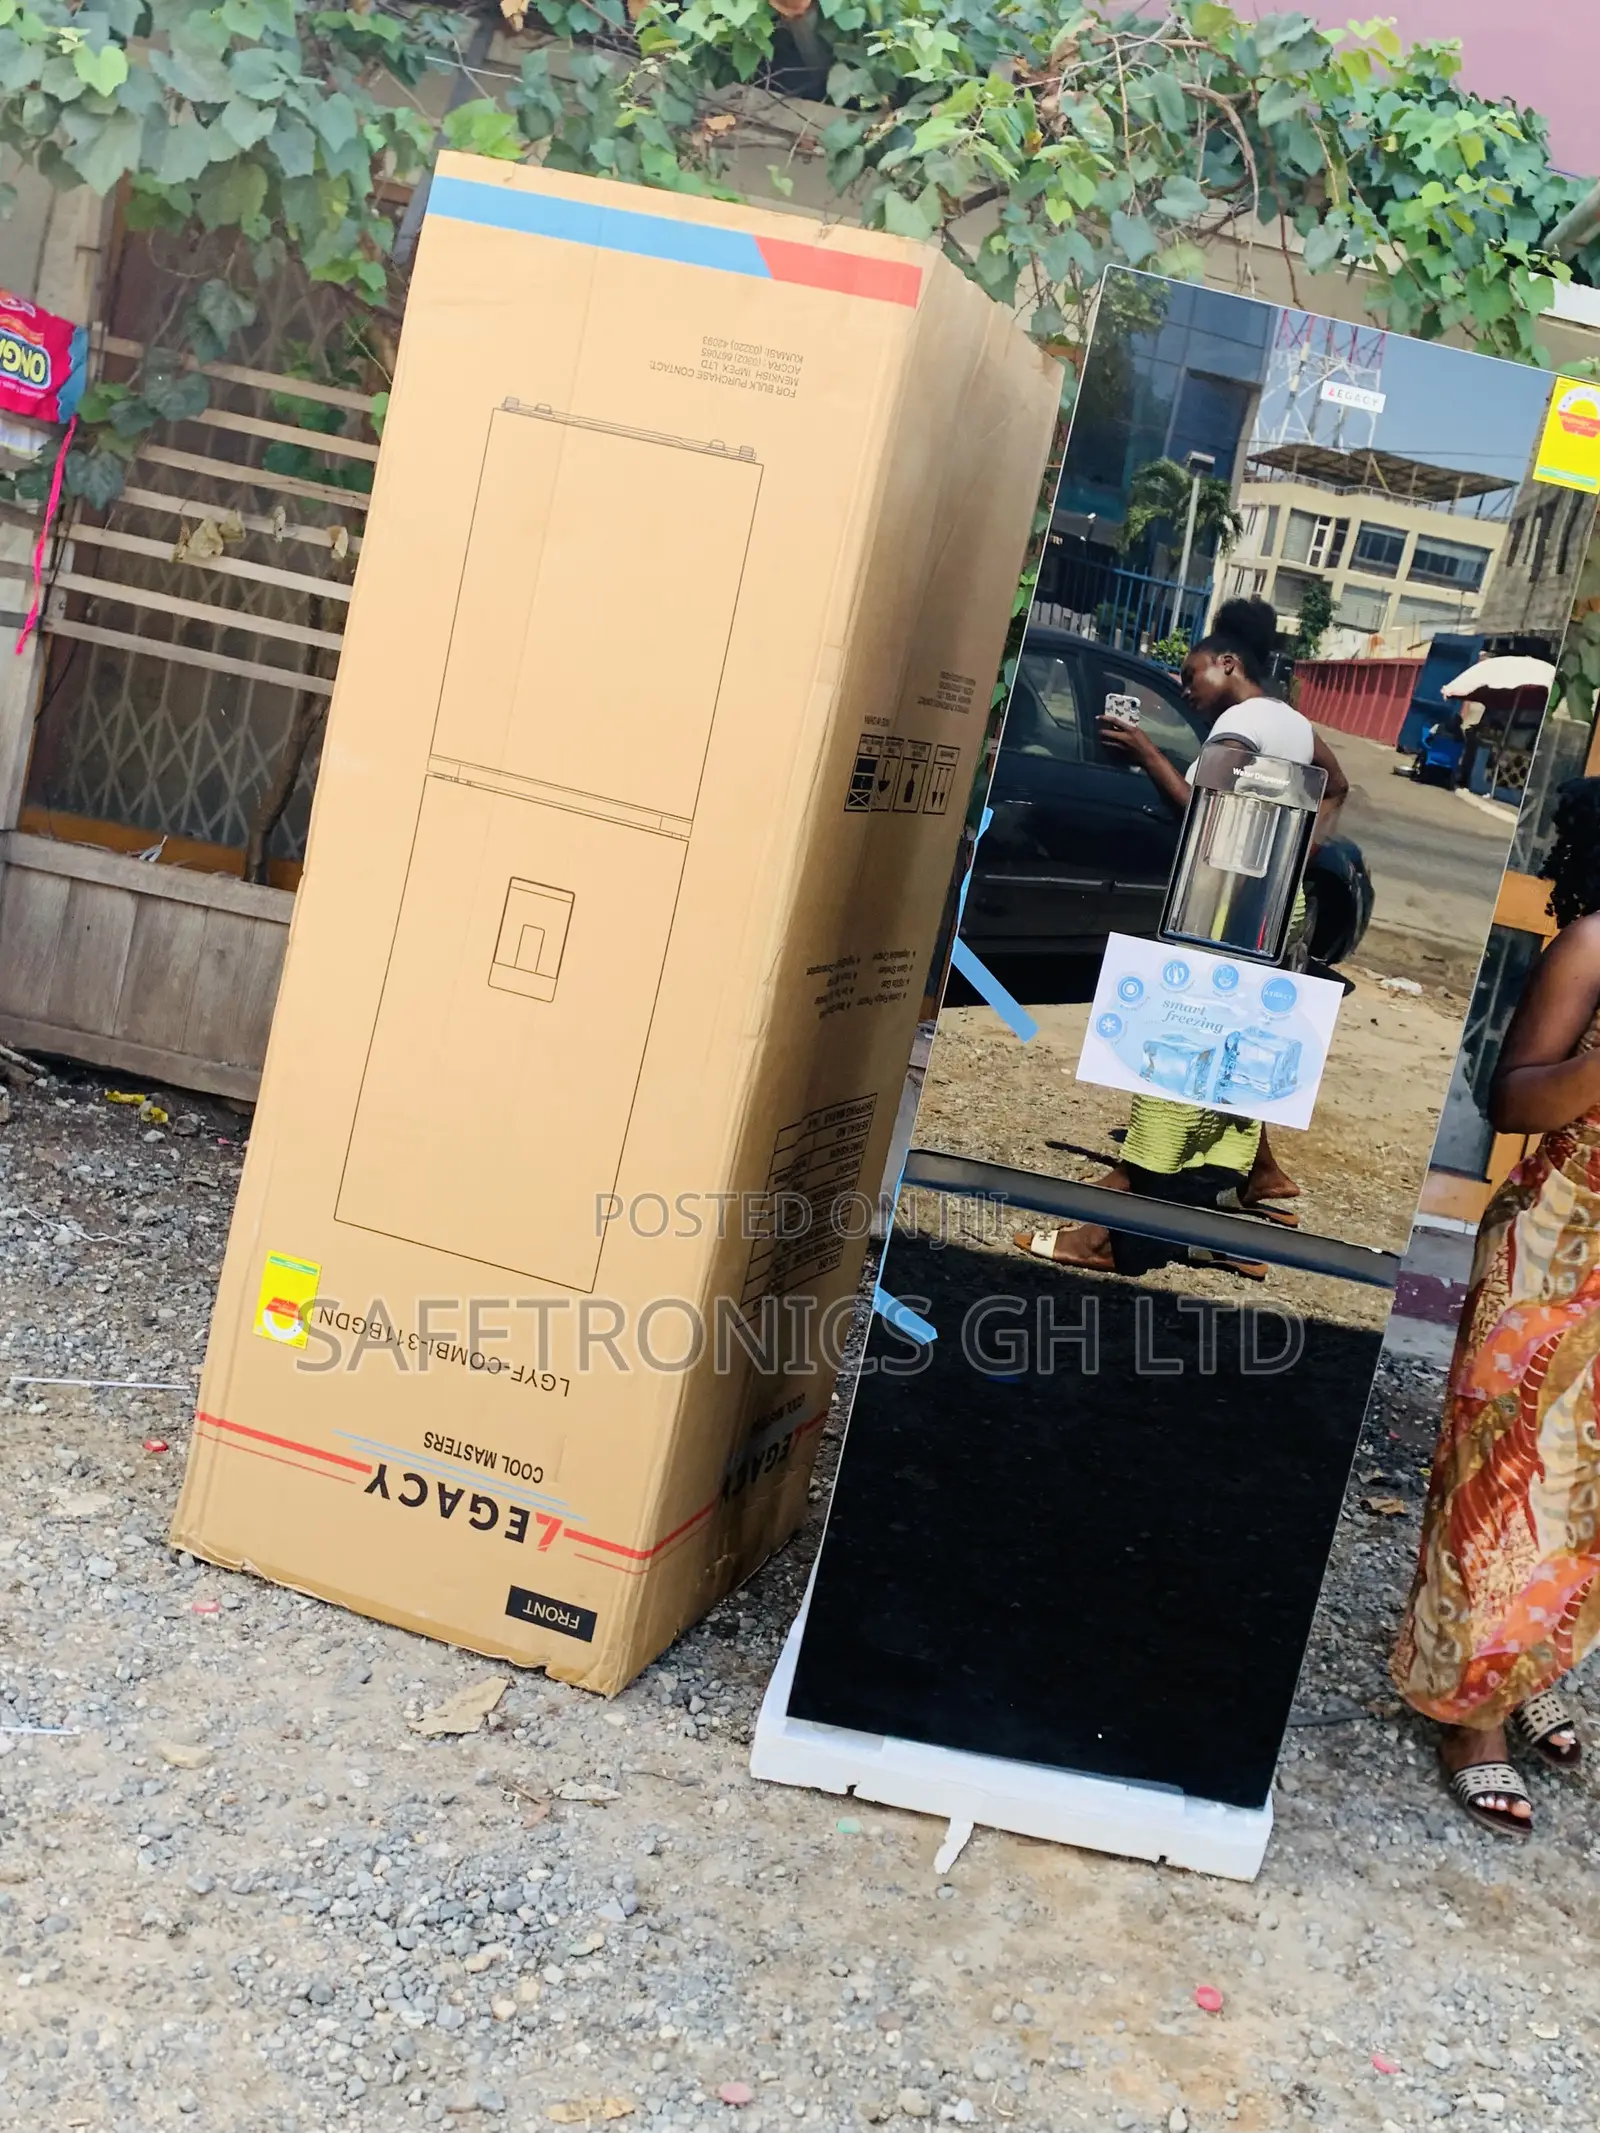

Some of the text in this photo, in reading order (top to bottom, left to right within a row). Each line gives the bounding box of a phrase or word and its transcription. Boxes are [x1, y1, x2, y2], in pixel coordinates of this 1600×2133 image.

[696, 370, 748, 388] PURCHASE
[700, 359, 800, 387] MENKISH IMPEX LTD
[749, 380, 775, 394] BULK
[775, 386, 797, 398] FOR
[1328, 387, 1379, 407] LEGACY
[1232, 766, 1291, 786] Water Dispenser
[1163, 999, 1207, 1017] smart
[1162, 1009, 1225, 1035] freezing
[319, 1307, 570, 1397] LGYF-COMBI-311BGDN
[423, 1431, 544, 1483] COOL MASTERS
[363, 1463, 564, 1553] LEGACY
[522, 1599, 581, 1630] FRONT
